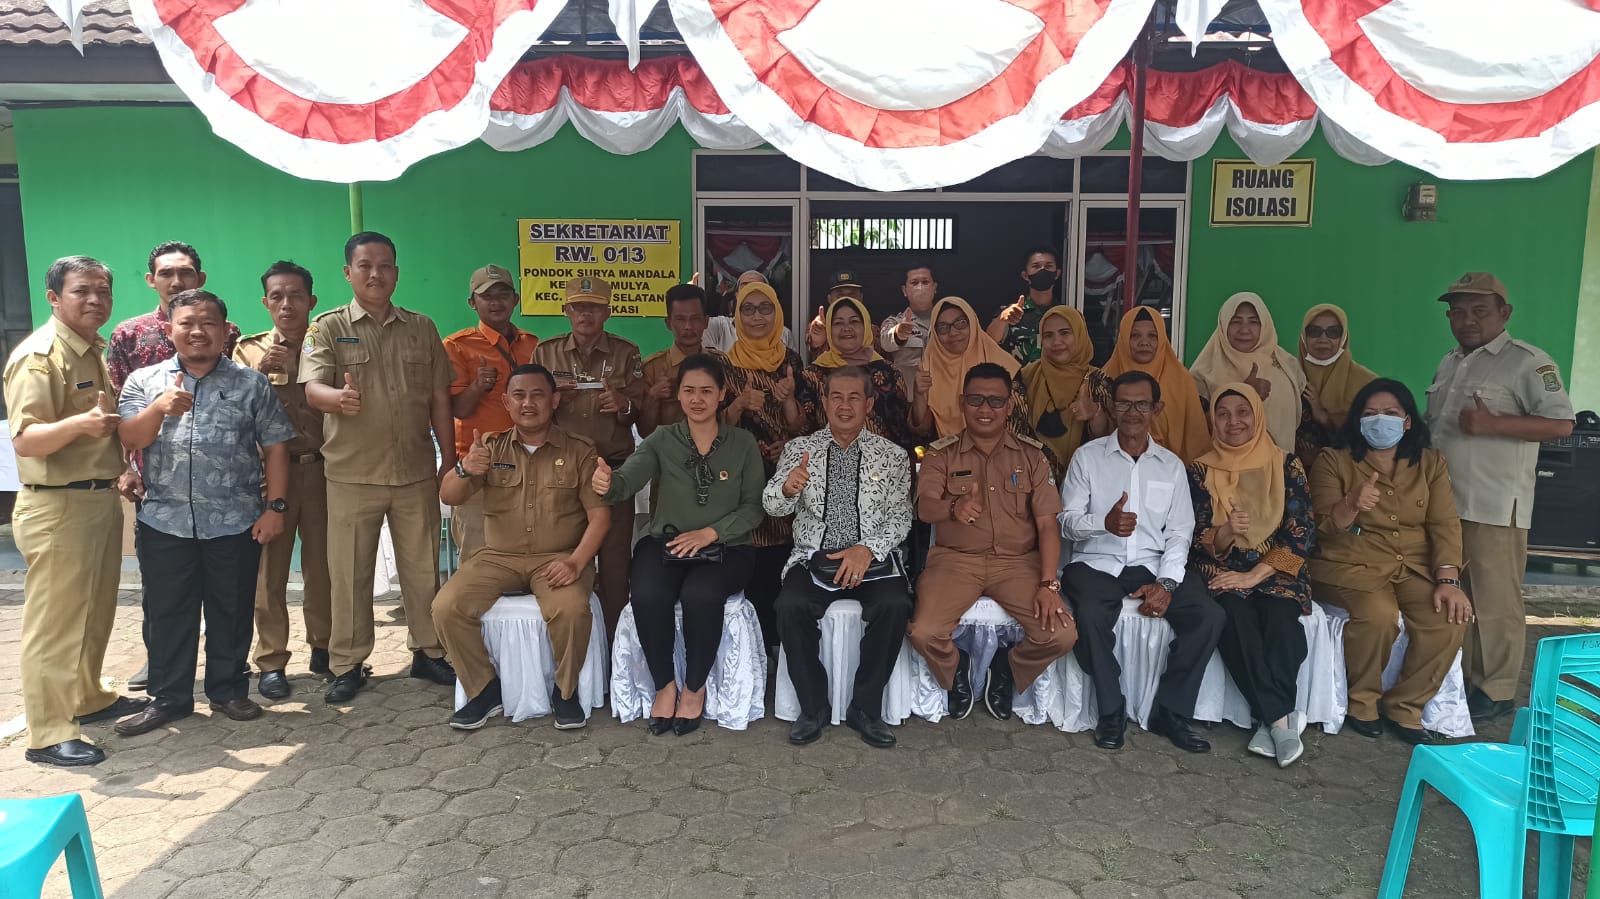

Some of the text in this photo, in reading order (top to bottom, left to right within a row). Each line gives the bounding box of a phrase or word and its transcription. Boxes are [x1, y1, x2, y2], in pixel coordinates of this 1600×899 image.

[1232, 169, 1294, 188] RUANG
[1226, 197, 1297, 216] ISOLASI
[530, 223, 669, 240] SEKRETARIAT
[555, 246, 645, 263] RW. 013
[524, 268, 675, 278] PONDOK SURYA MANDALA
[550, 280, 568, 289] KE
[535, 292, 665, 302] KEC. SELATAN
[610, 305, 639, 313] KASI
